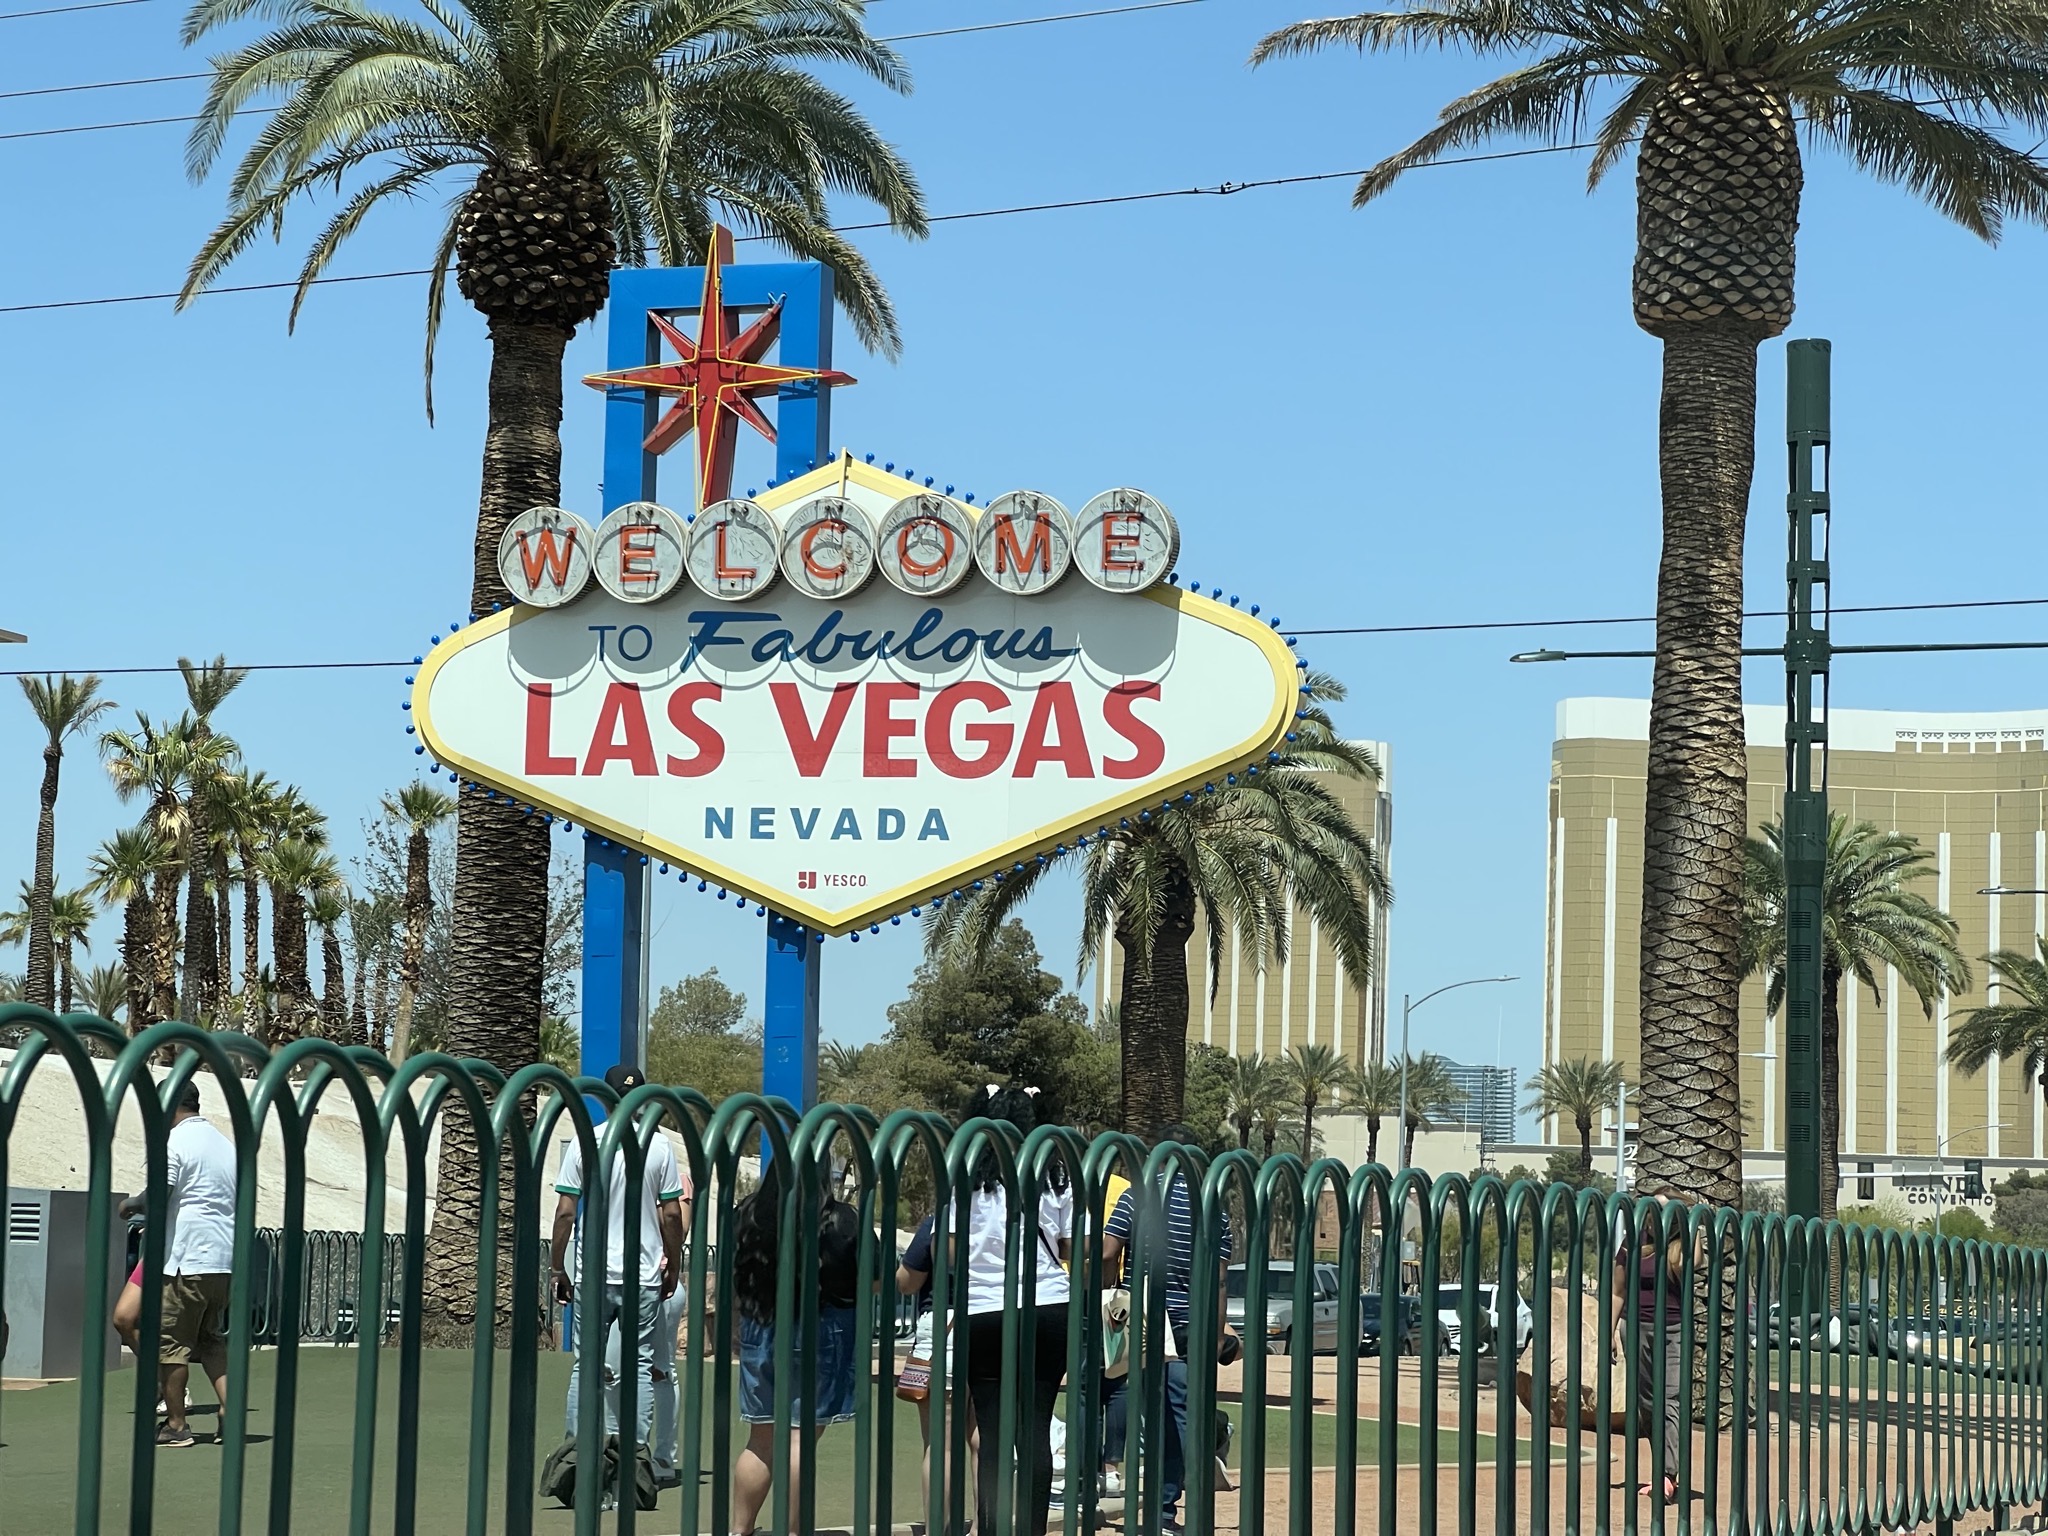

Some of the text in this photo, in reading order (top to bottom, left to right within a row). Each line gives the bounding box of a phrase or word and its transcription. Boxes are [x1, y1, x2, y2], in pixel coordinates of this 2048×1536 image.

[515, 511, 1145, 590] WELCOME
[588, 607, 1080, 673] TO Fabulous
[525, 681, 1166, 779] LAS VEGAS
[704, 806, 950, 841] NEVADA
[823, 874, 867, 887] YESCO
